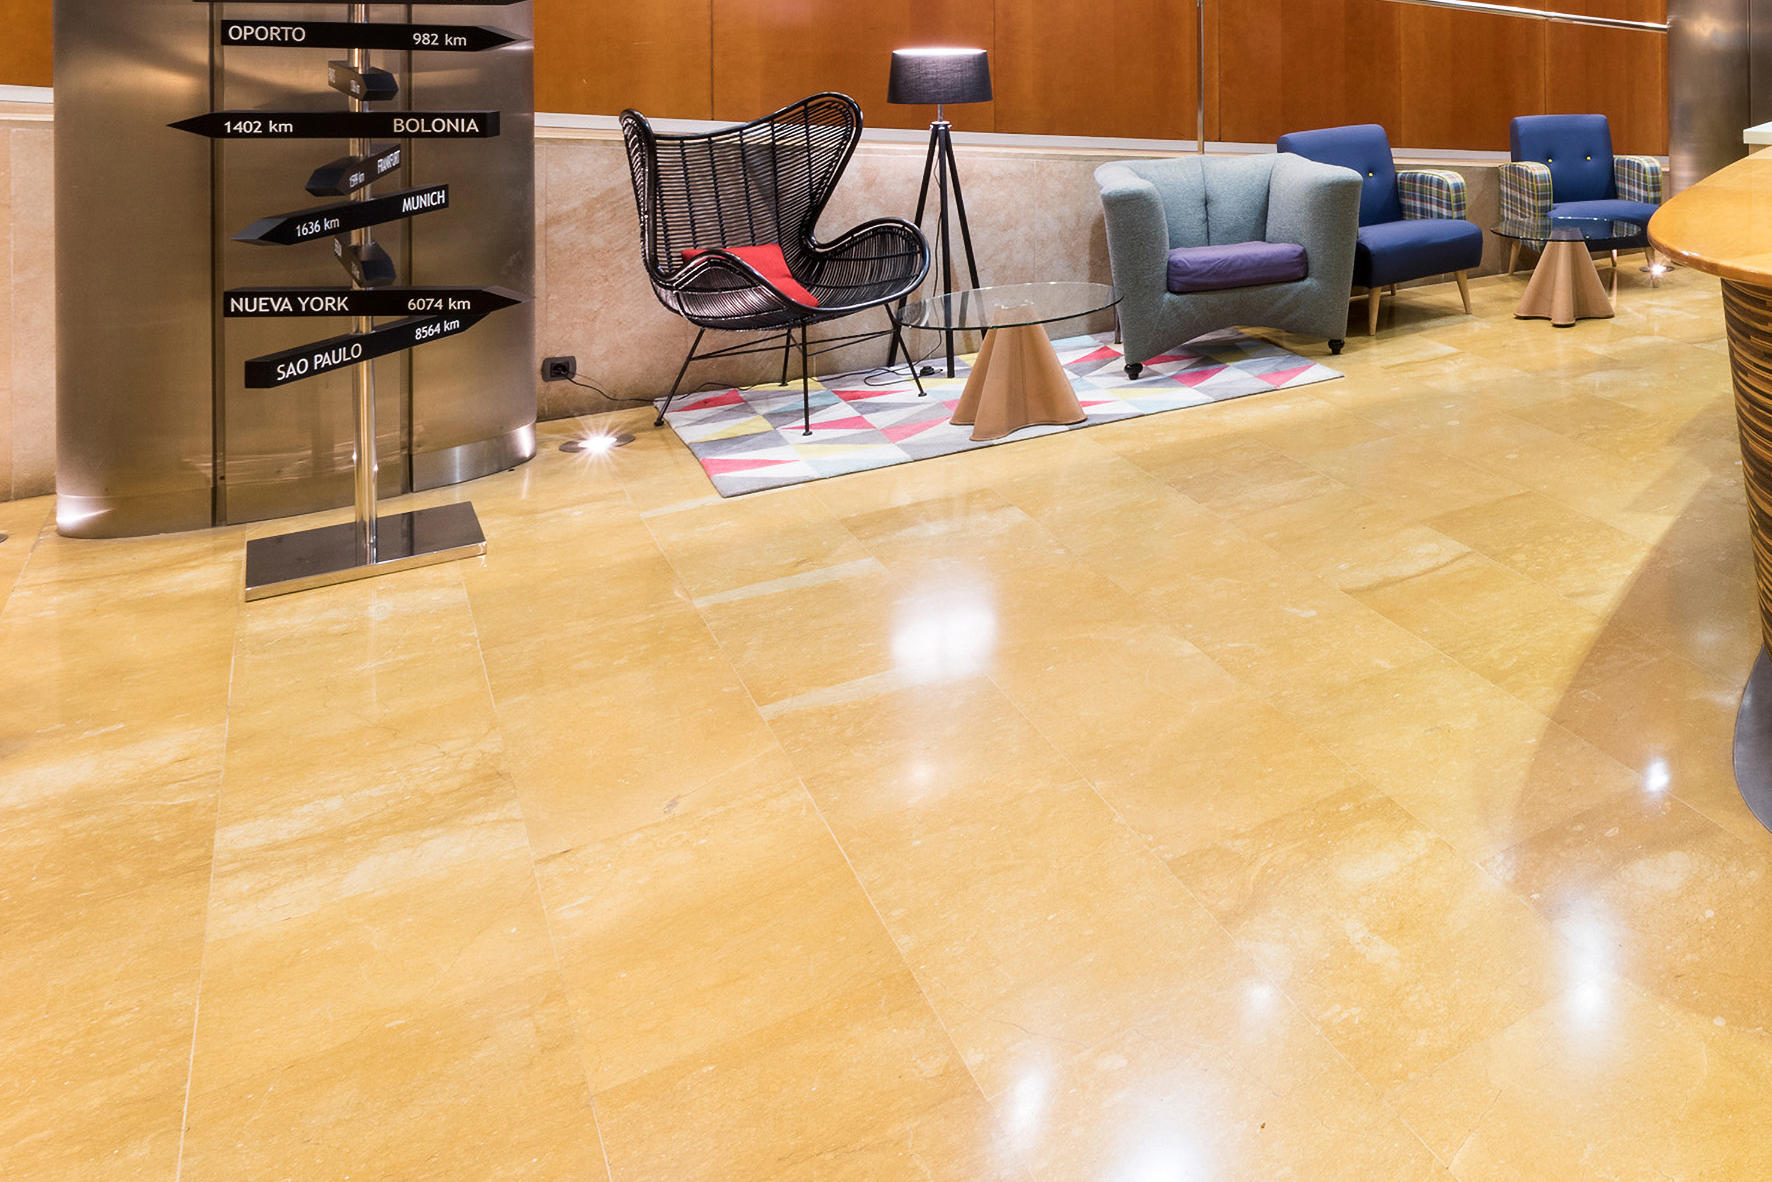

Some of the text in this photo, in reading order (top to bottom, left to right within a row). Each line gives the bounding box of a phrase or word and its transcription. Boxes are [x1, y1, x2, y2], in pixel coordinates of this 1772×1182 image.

[228, 24, 467, 46] OPORTO 982 km
[224, 118, 480, 134] 1402 km BOLONIA
[295, 189, 446, 237] 1636 km MUNICH
[229, 296, 471, 313] NUEVA YORK 6074 km
[276, 318, 460, 381] SAO PAULO 8564 km
